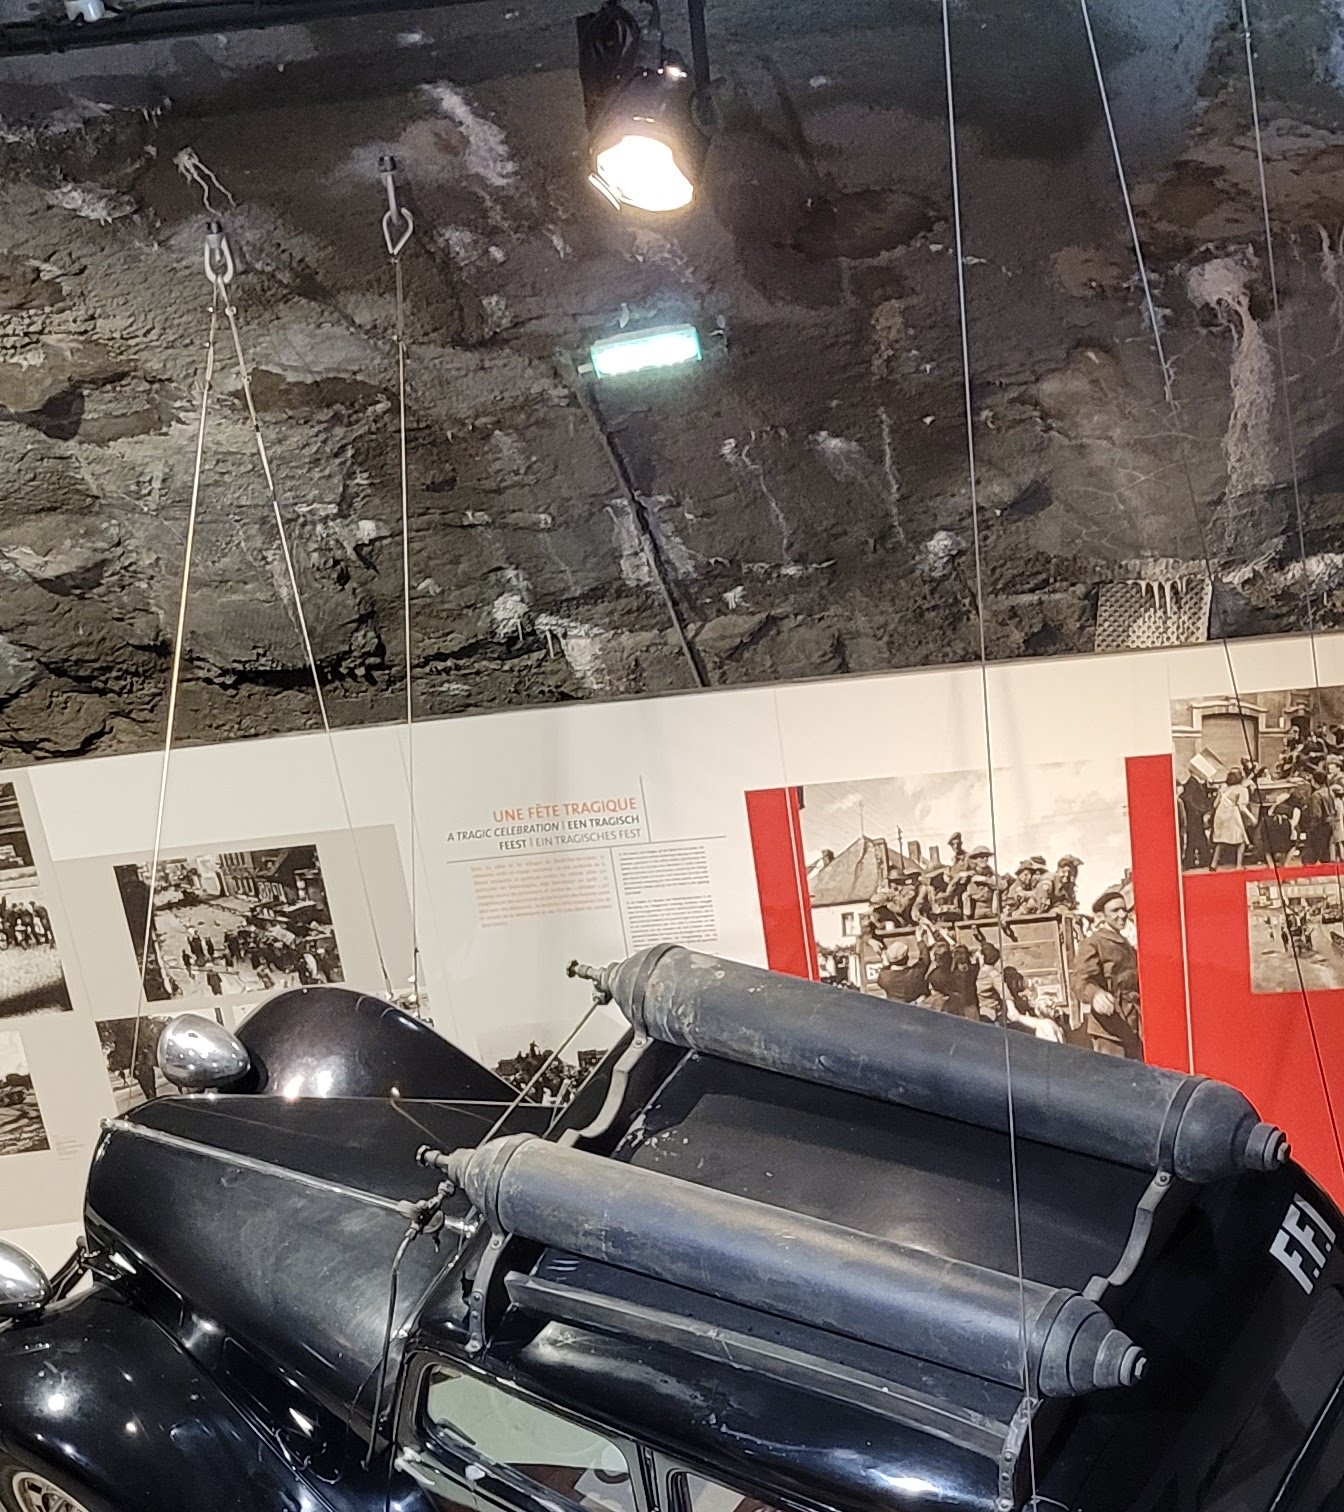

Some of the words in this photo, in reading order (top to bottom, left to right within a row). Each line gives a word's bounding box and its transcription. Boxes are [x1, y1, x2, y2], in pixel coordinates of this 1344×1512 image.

[492, 809, 523, 823] UNE
[528, 803, 560, 820] FÊTE
[562, 797, 637, 816] TRAGIQUE
[447, 832, 455, 842] A
[457, 828, 492, 841] TRAGIC
[494, 822, 560, 837] CELEBRATION
[568, 819, 588, 830] EEN
[589, 815, 640, 828] TRAGISCH
[499, 840, 527, 851] FEEST
[535, 836, 553, 848] EIN
[554, 830, 617, 845] TRAGISCHES
[618, 828, 642, 840] FEST
